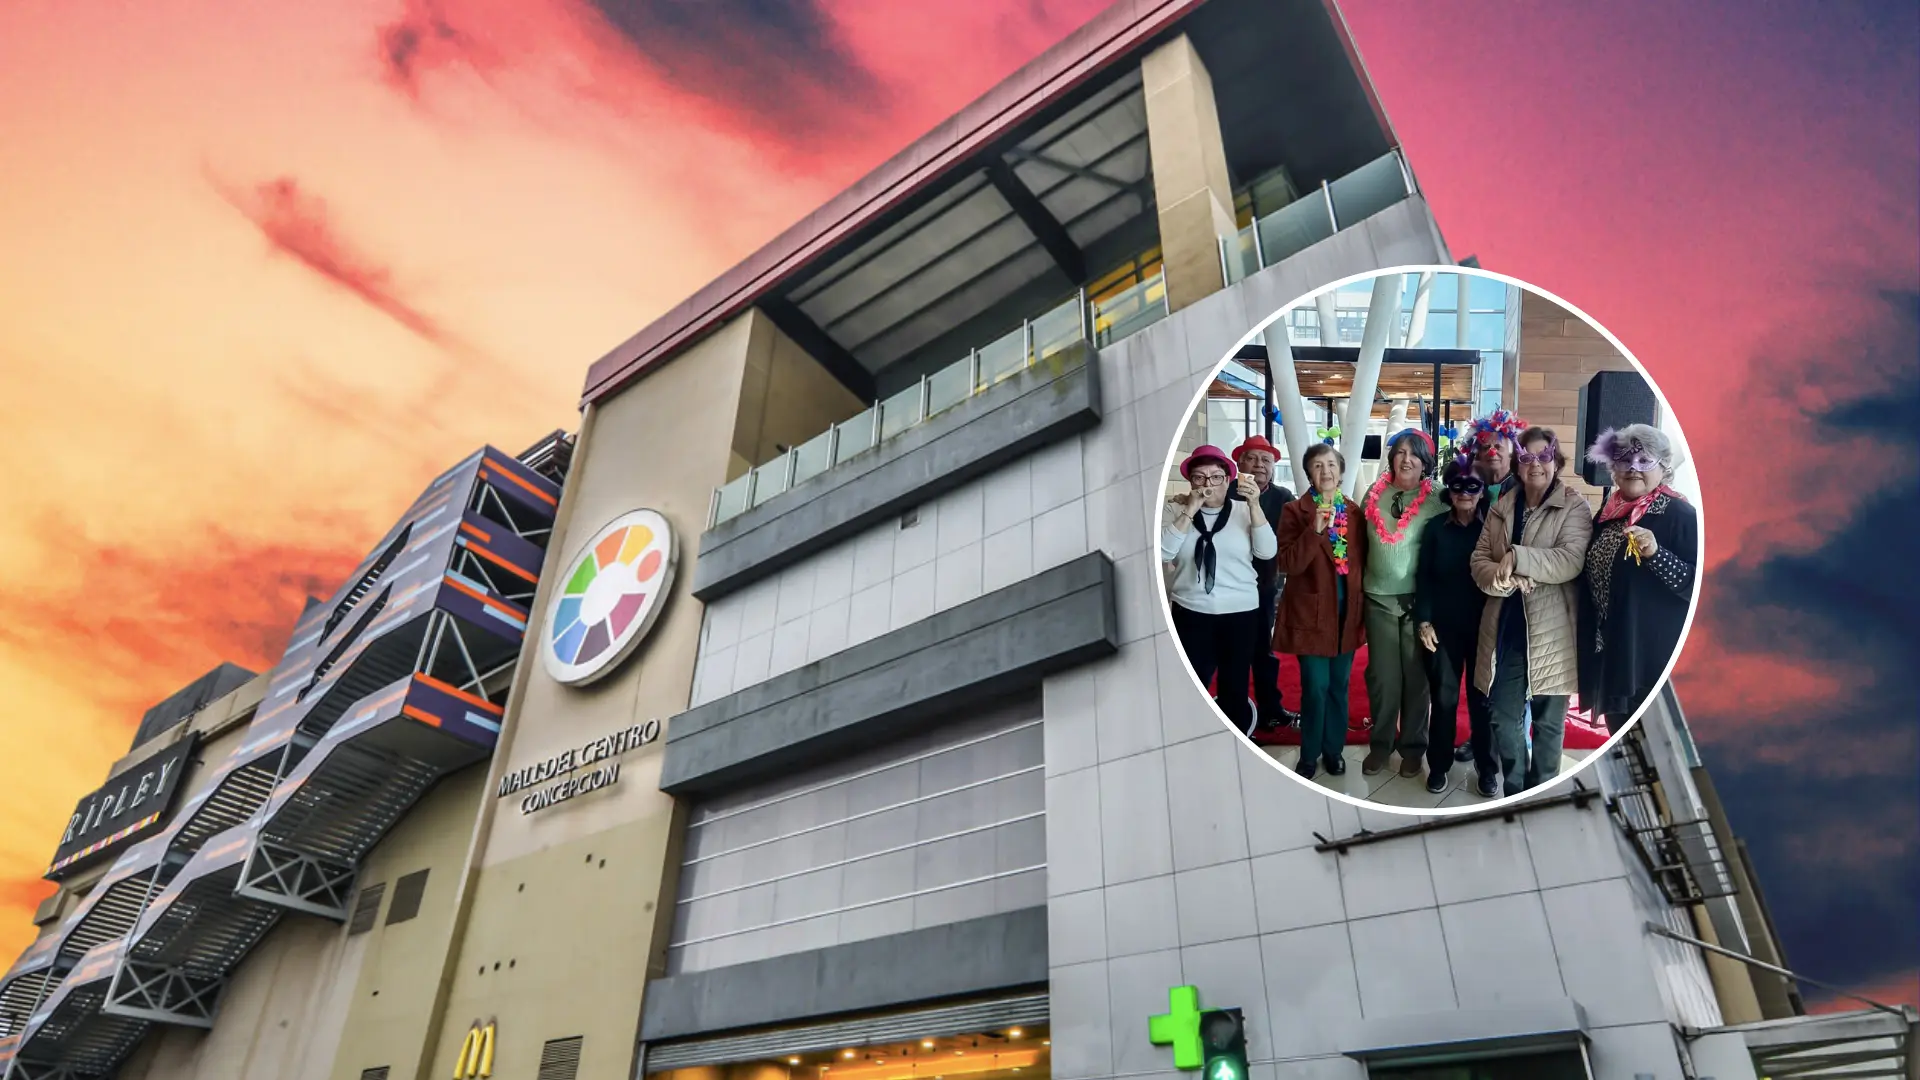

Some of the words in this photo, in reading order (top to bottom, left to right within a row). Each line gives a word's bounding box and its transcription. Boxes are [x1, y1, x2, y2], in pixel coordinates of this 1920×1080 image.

[498, 762, 545, 798] MALL
[544, 749, 578, 779] DEL
[580, 718, 661, 766] CENTRO
[520, 763, 620, 815] CONCEPCION
